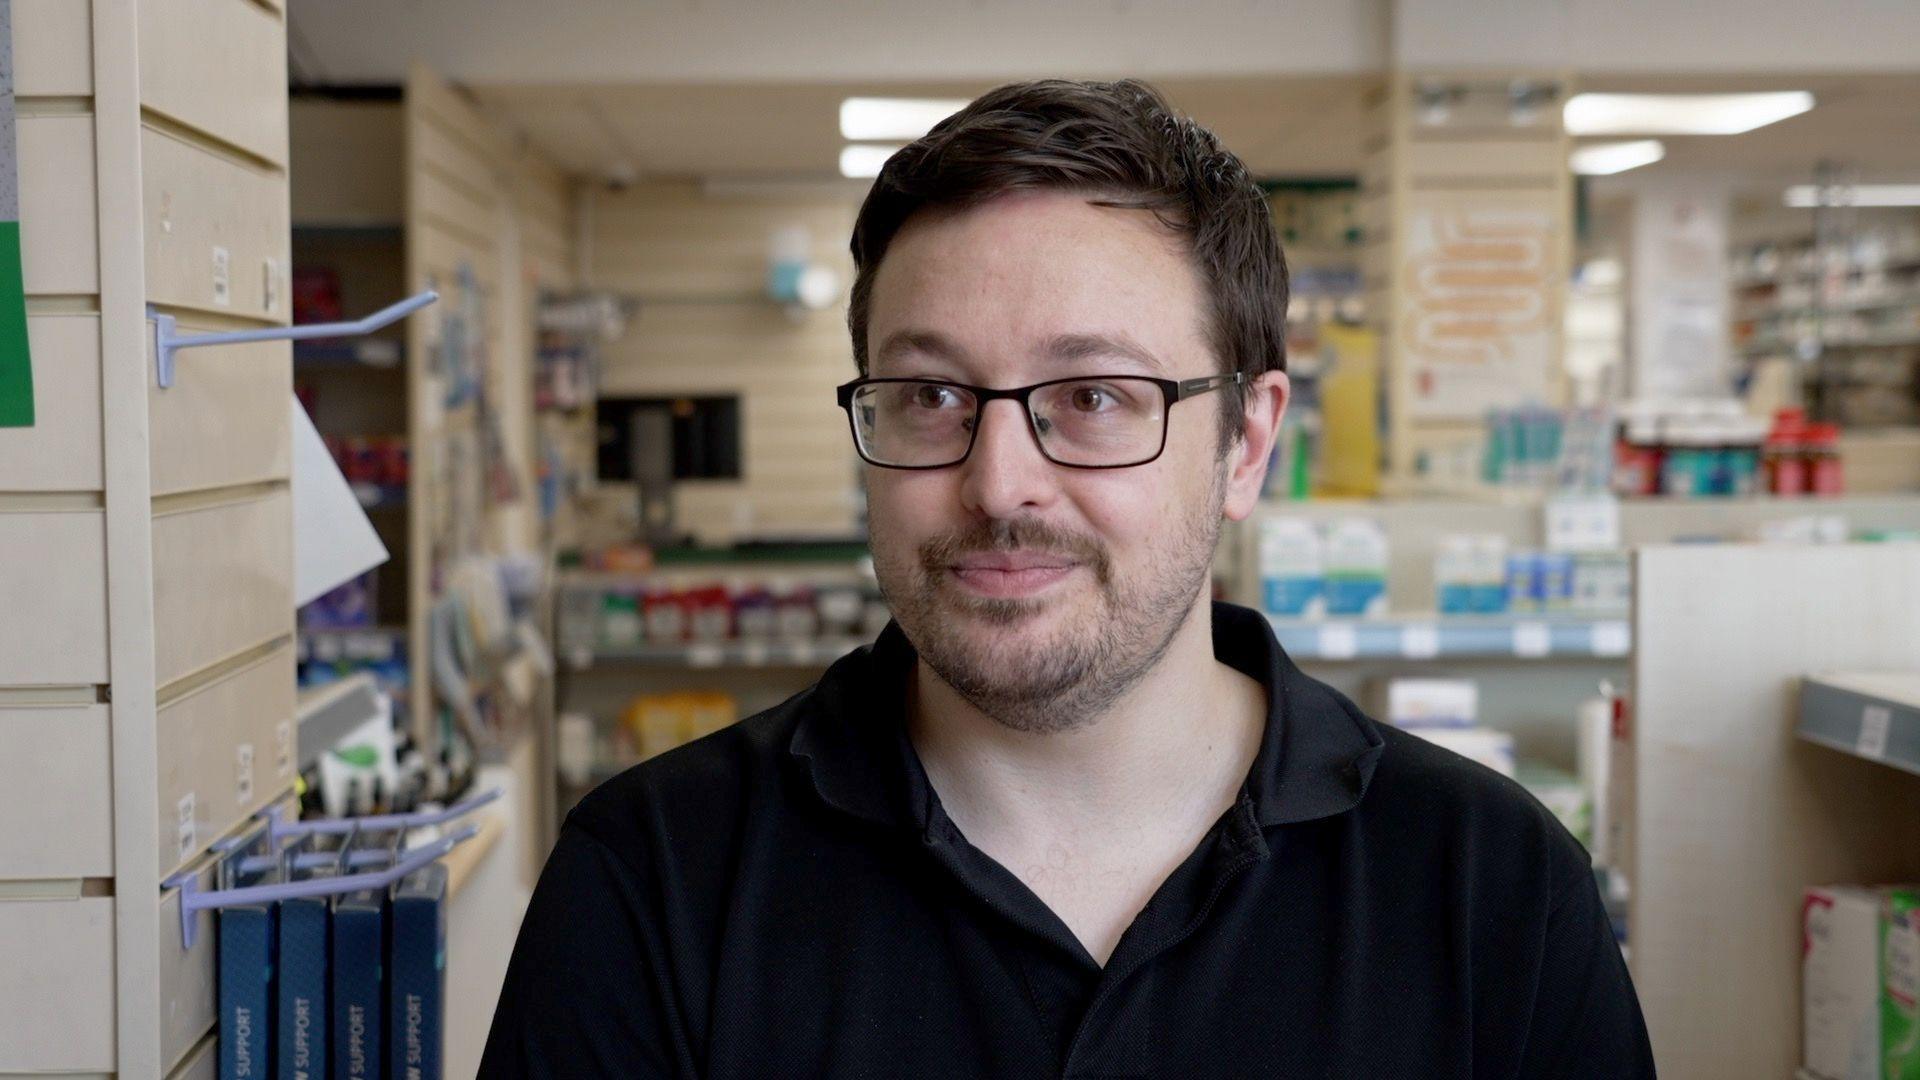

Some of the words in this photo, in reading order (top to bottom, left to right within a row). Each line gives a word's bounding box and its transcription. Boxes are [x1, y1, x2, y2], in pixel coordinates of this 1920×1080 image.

[237, 1006, 250, 1077] SUPPORT
[295, 997, 310, 1068] SUPPORT
[350, 1005, 364, 1074] SUPPORT
[407, 993, 421, 1064] SUPPORT
